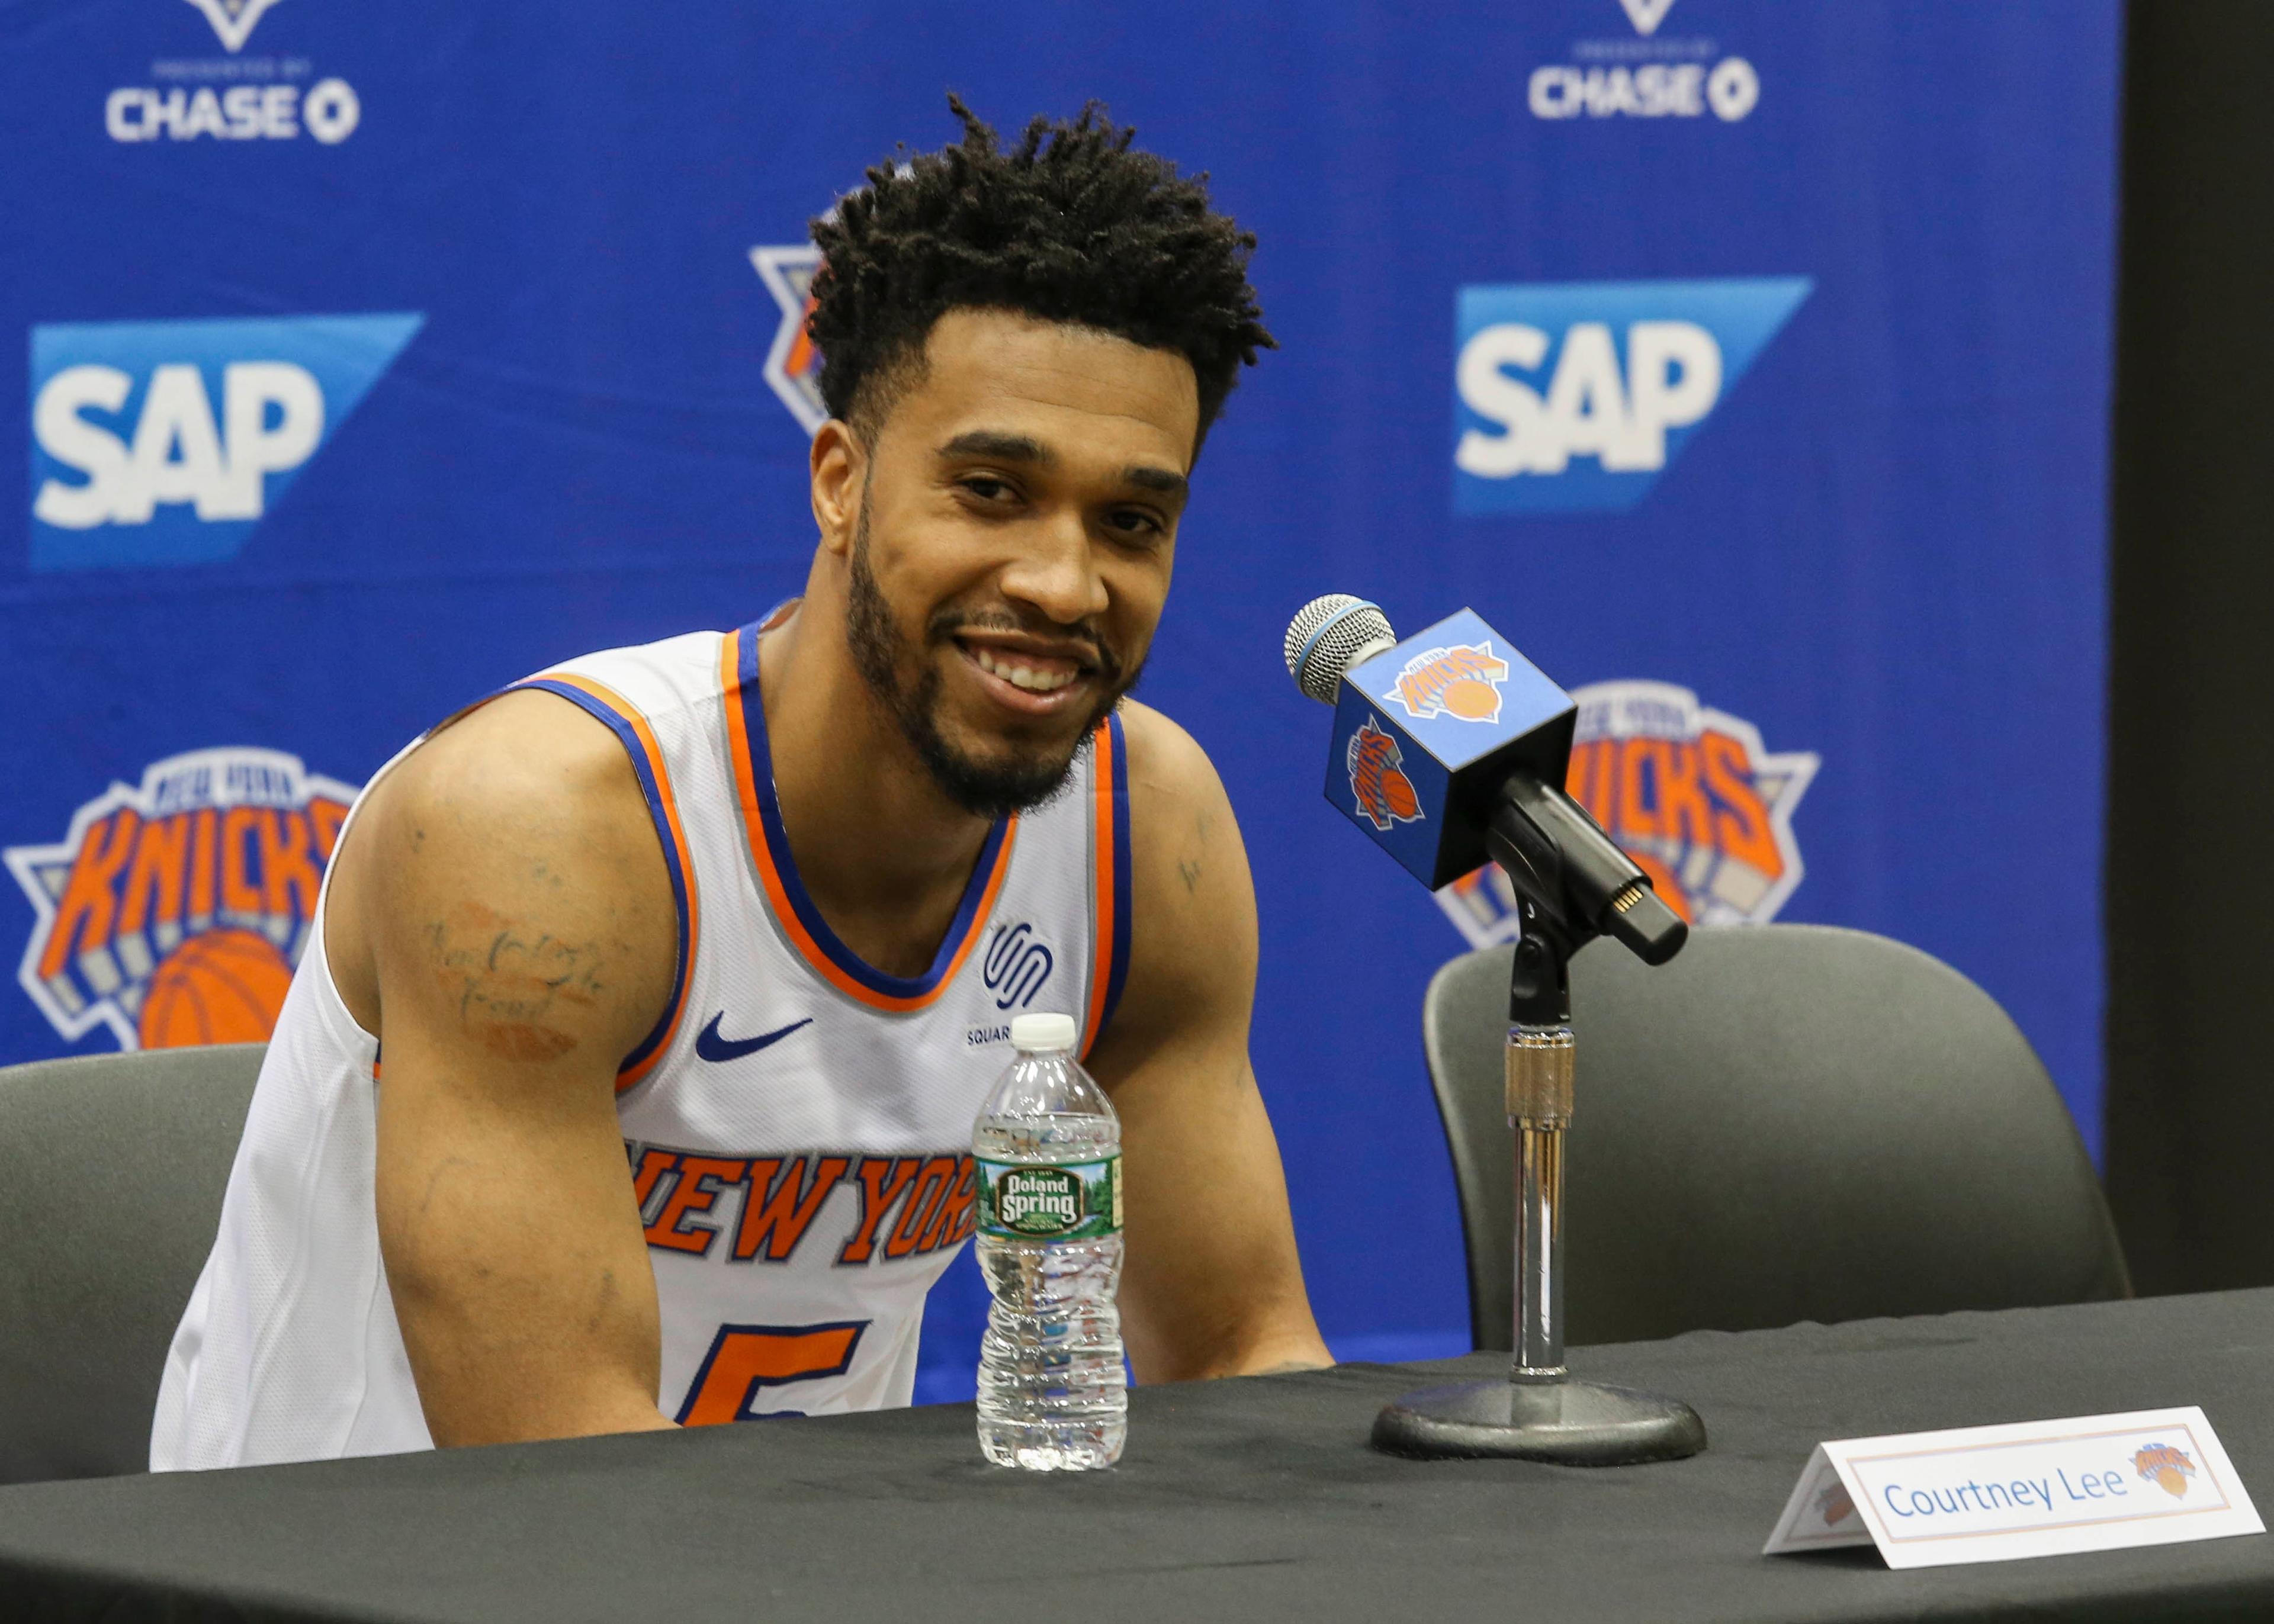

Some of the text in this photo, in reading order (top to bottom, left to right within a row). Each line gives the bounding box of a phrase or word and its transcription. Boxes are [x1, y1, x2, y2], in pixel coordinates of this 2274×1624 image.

[105, 86, 298, 142] CHASE
[1529, 63, 1706, 118] CHASE
[1456, 320, 1722, 478] SAP
[34, 362, 325, 529] SAP
[1399, 648, 1505, 713] KNICKS
[1354, 729, 1394, 826] KNICKS
[967, 1025, 1010, 1046] SQUAR
[836, 1153, 976, 1264] YOR
[1001, 1192, 1077, 1224] Spring
[1007, 1175, 1068, 1195] Poland
[1884, 1468, 2128, 1517] Courtney Lee
